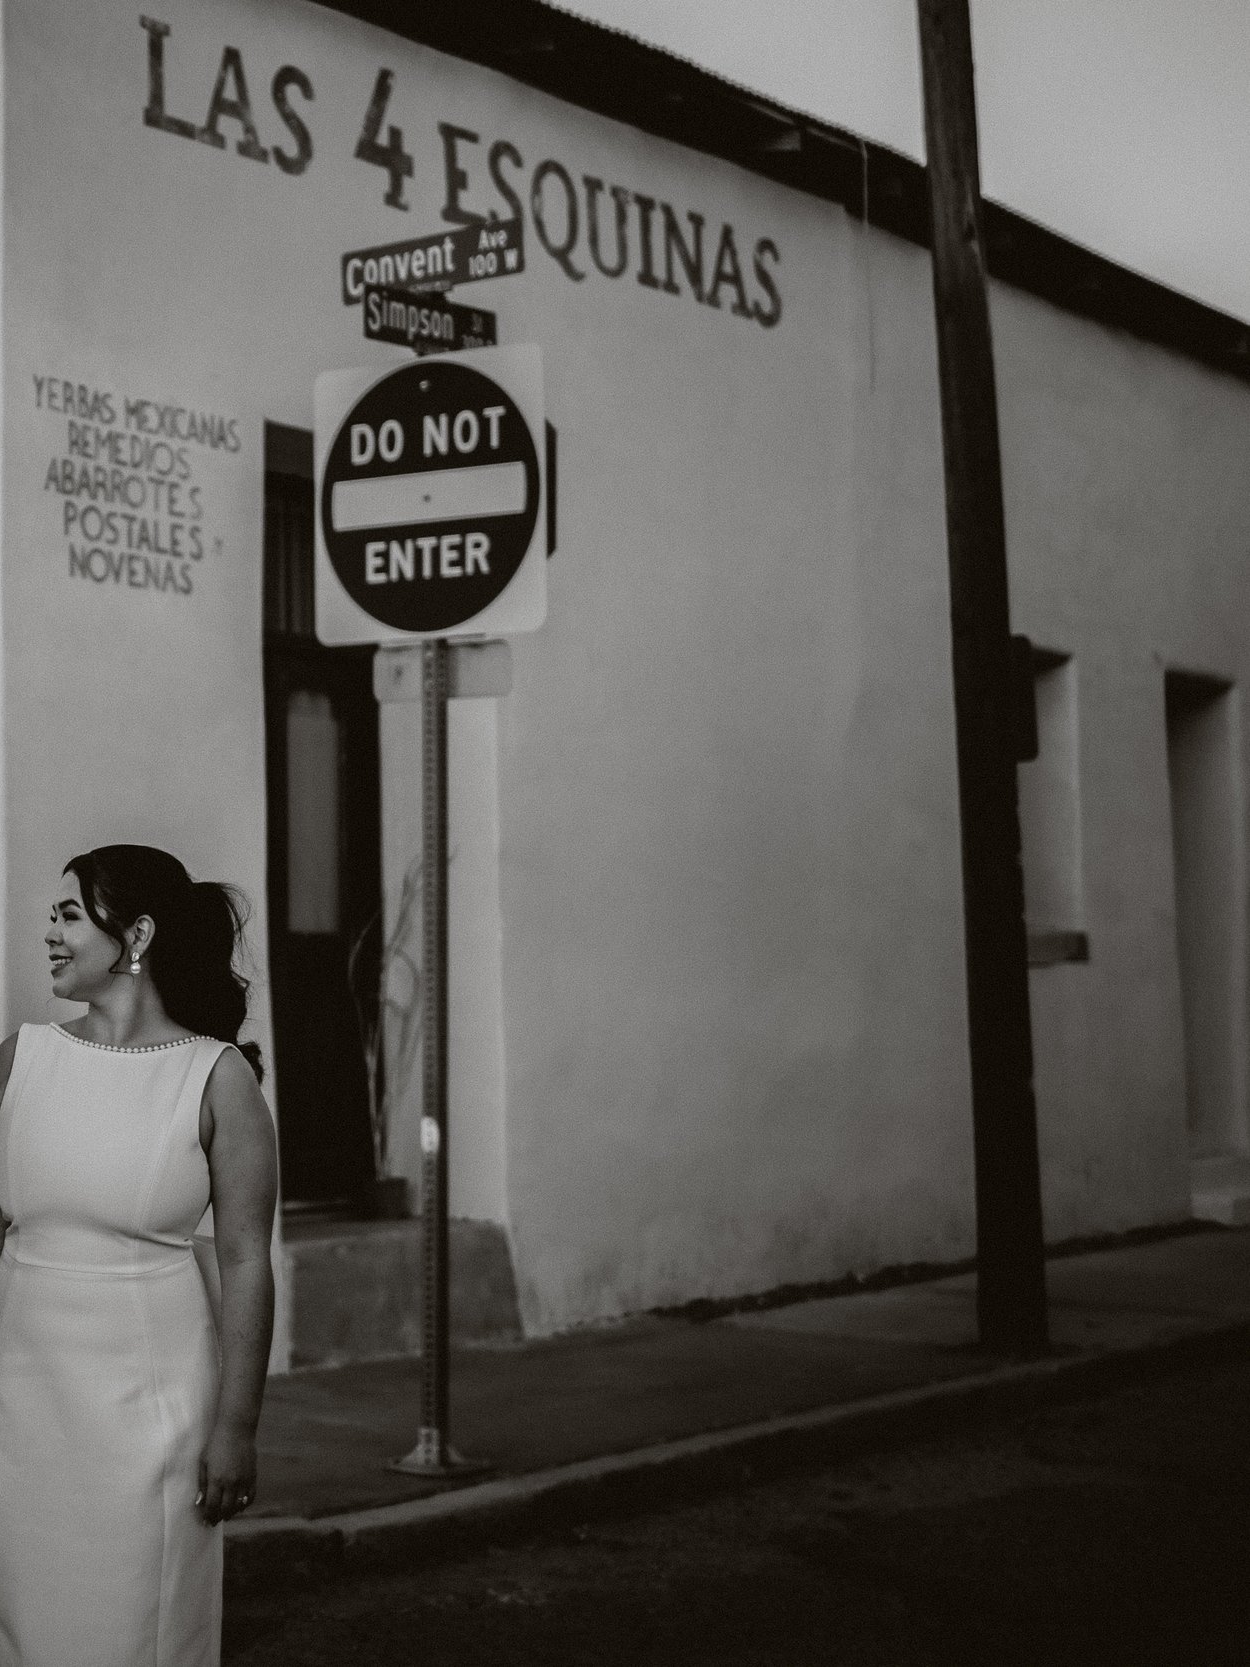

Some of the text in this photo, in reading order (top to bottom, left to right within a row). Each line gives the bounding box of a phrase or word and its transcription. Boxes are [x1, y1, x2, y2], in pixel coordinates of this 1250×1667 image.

[139, 14, 782, 329] LAS 4 ESQUINAS
[346, 236, 455, 297] Convent
[468, 252, 498, 277] 100
[477, 229, 507, 250] Ave
[367, 291, 455, 342] Simpson
[32, 373, 241, 453] YERBAS MEXICANAS
[350, 405, 506, 467] DO NOT
[68, 419, 190, 480] REMEDIOS
[45, 457, 203, 519] ABARROTES
[64, 500, 203, 562] POSTALES
[365, 531, 491, 585] ENTER
[68, 542, 193, 595] NOVENAS
